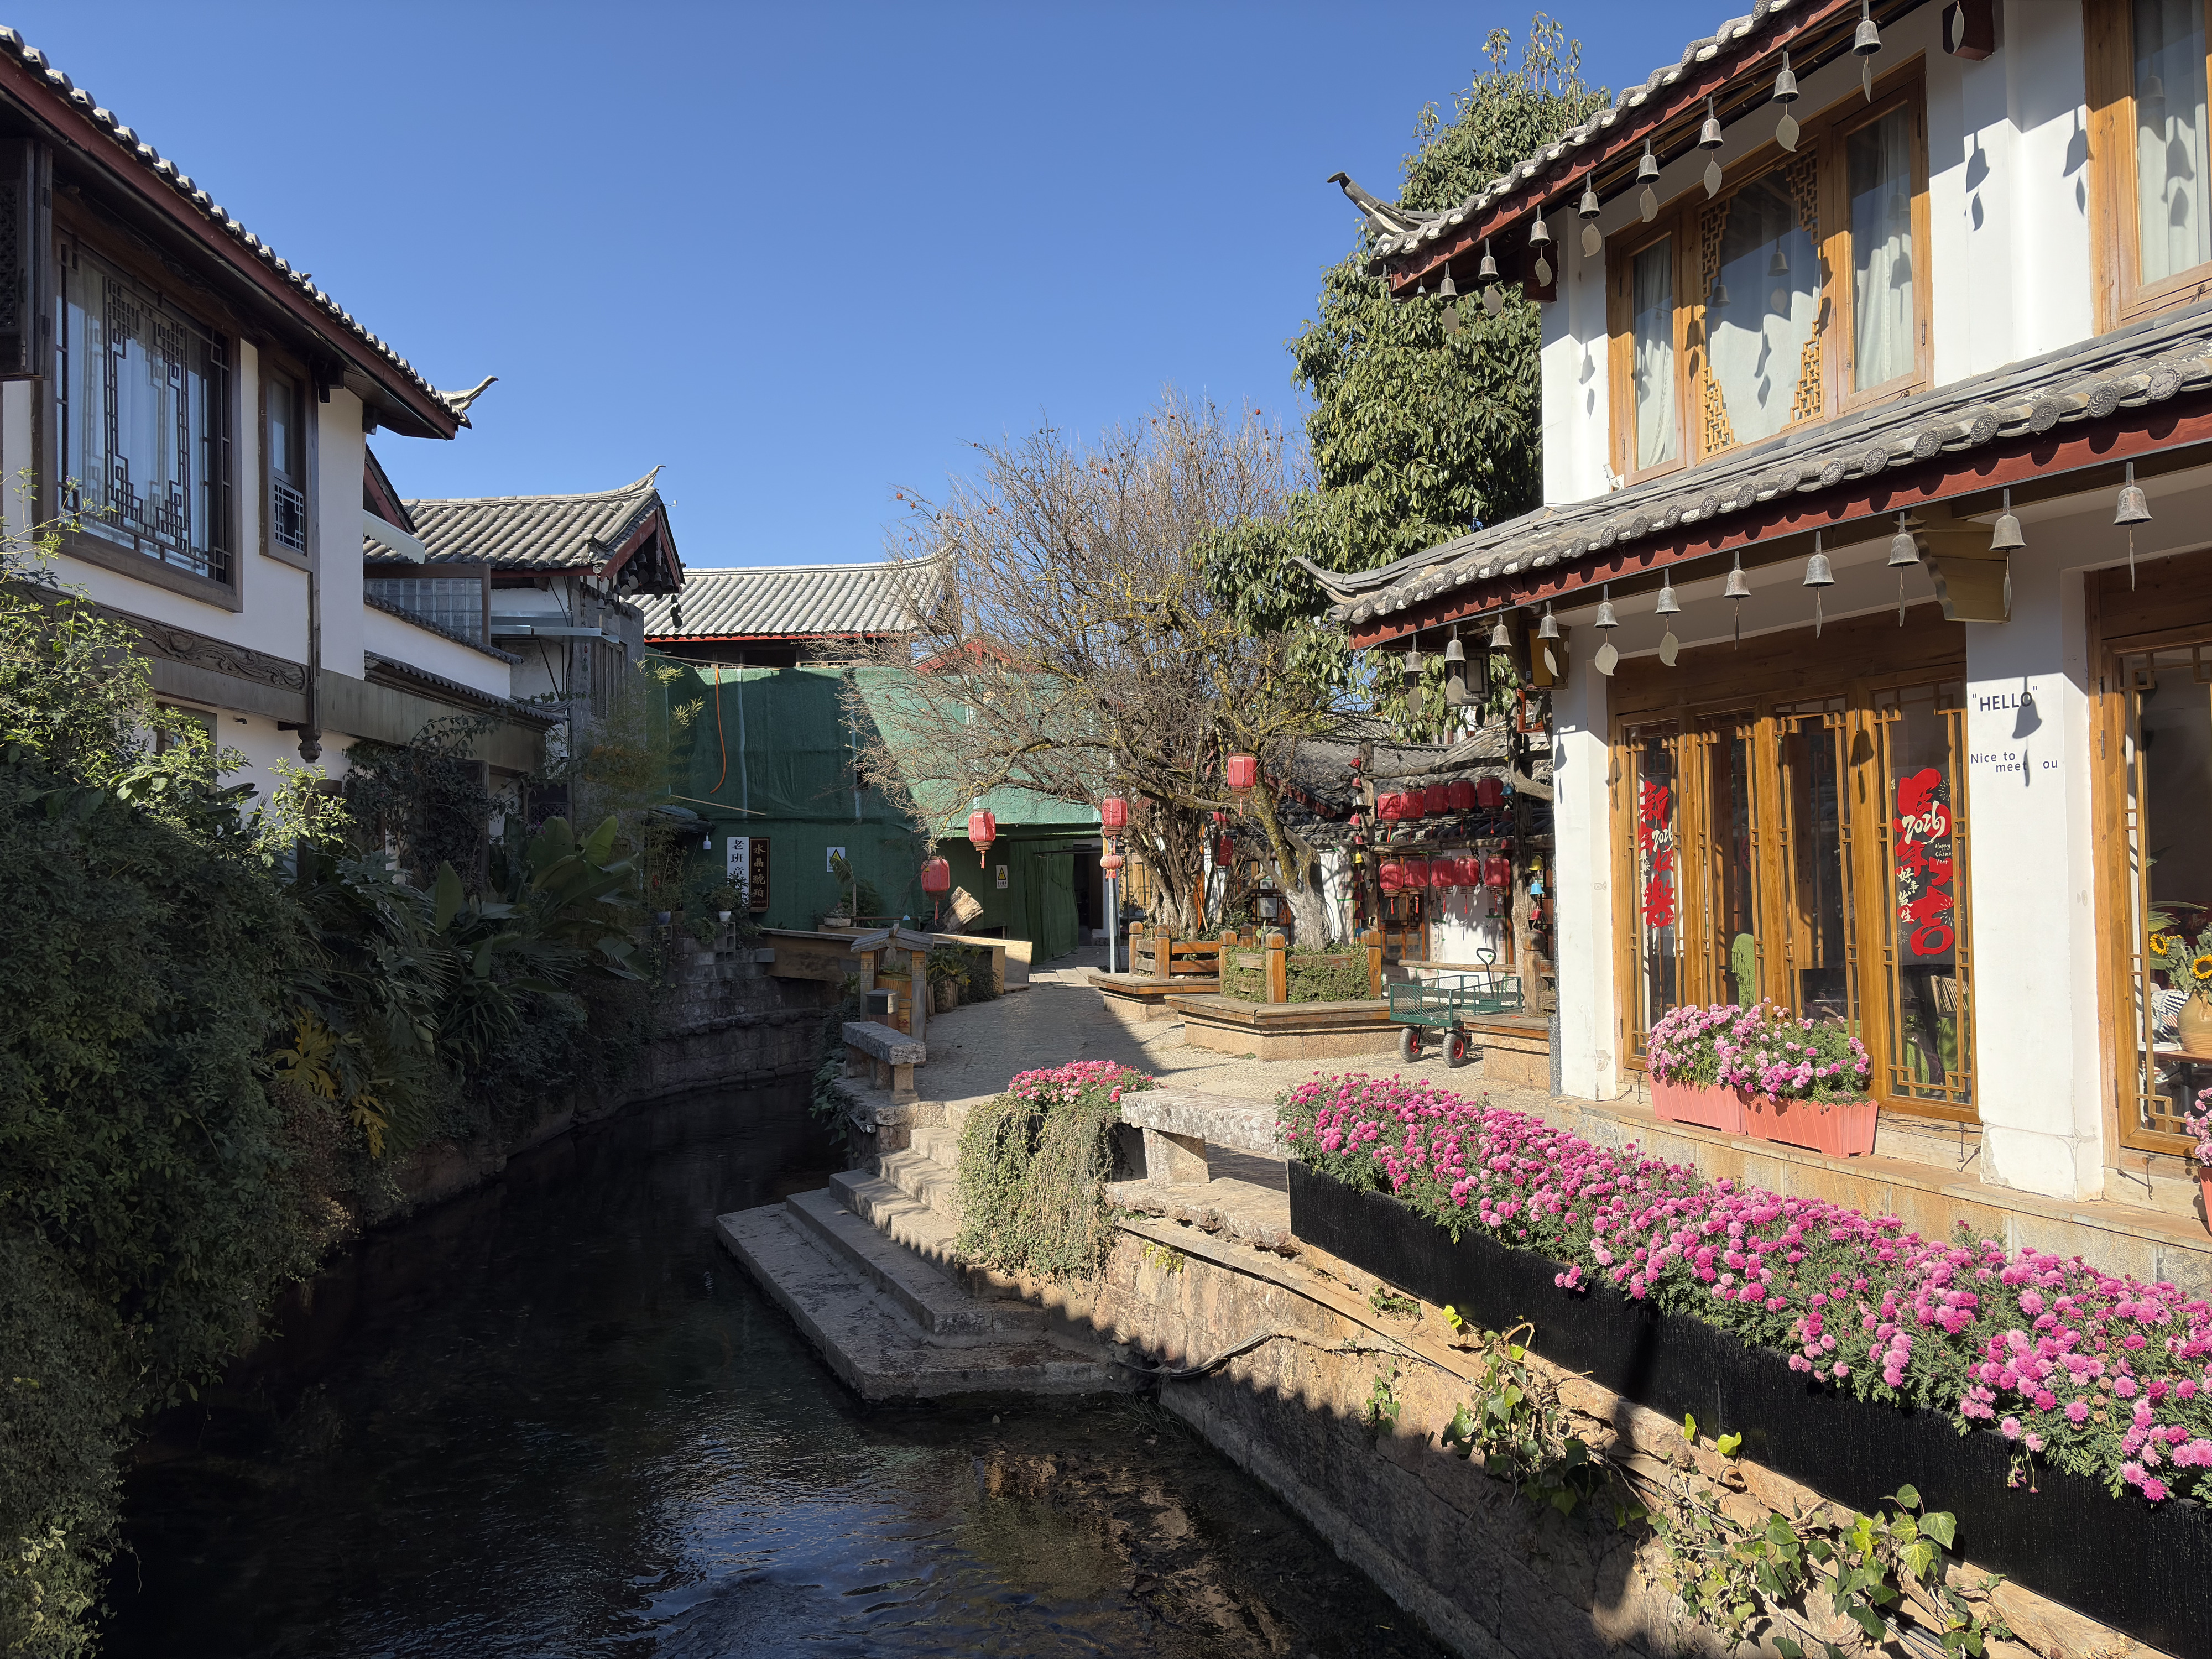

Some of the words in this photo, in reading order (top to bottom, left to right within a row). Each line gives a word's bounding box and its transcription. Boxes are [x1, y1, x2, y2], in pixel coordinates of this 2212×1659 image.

[1971, 753, 1997, 764] Nice
[2003, 752, 2016, 761] to
[1996, 761, 2027, 773] meet
[1902, 800, 1945, 844] 2026
[1935, 842, 1951, 851] Happy
